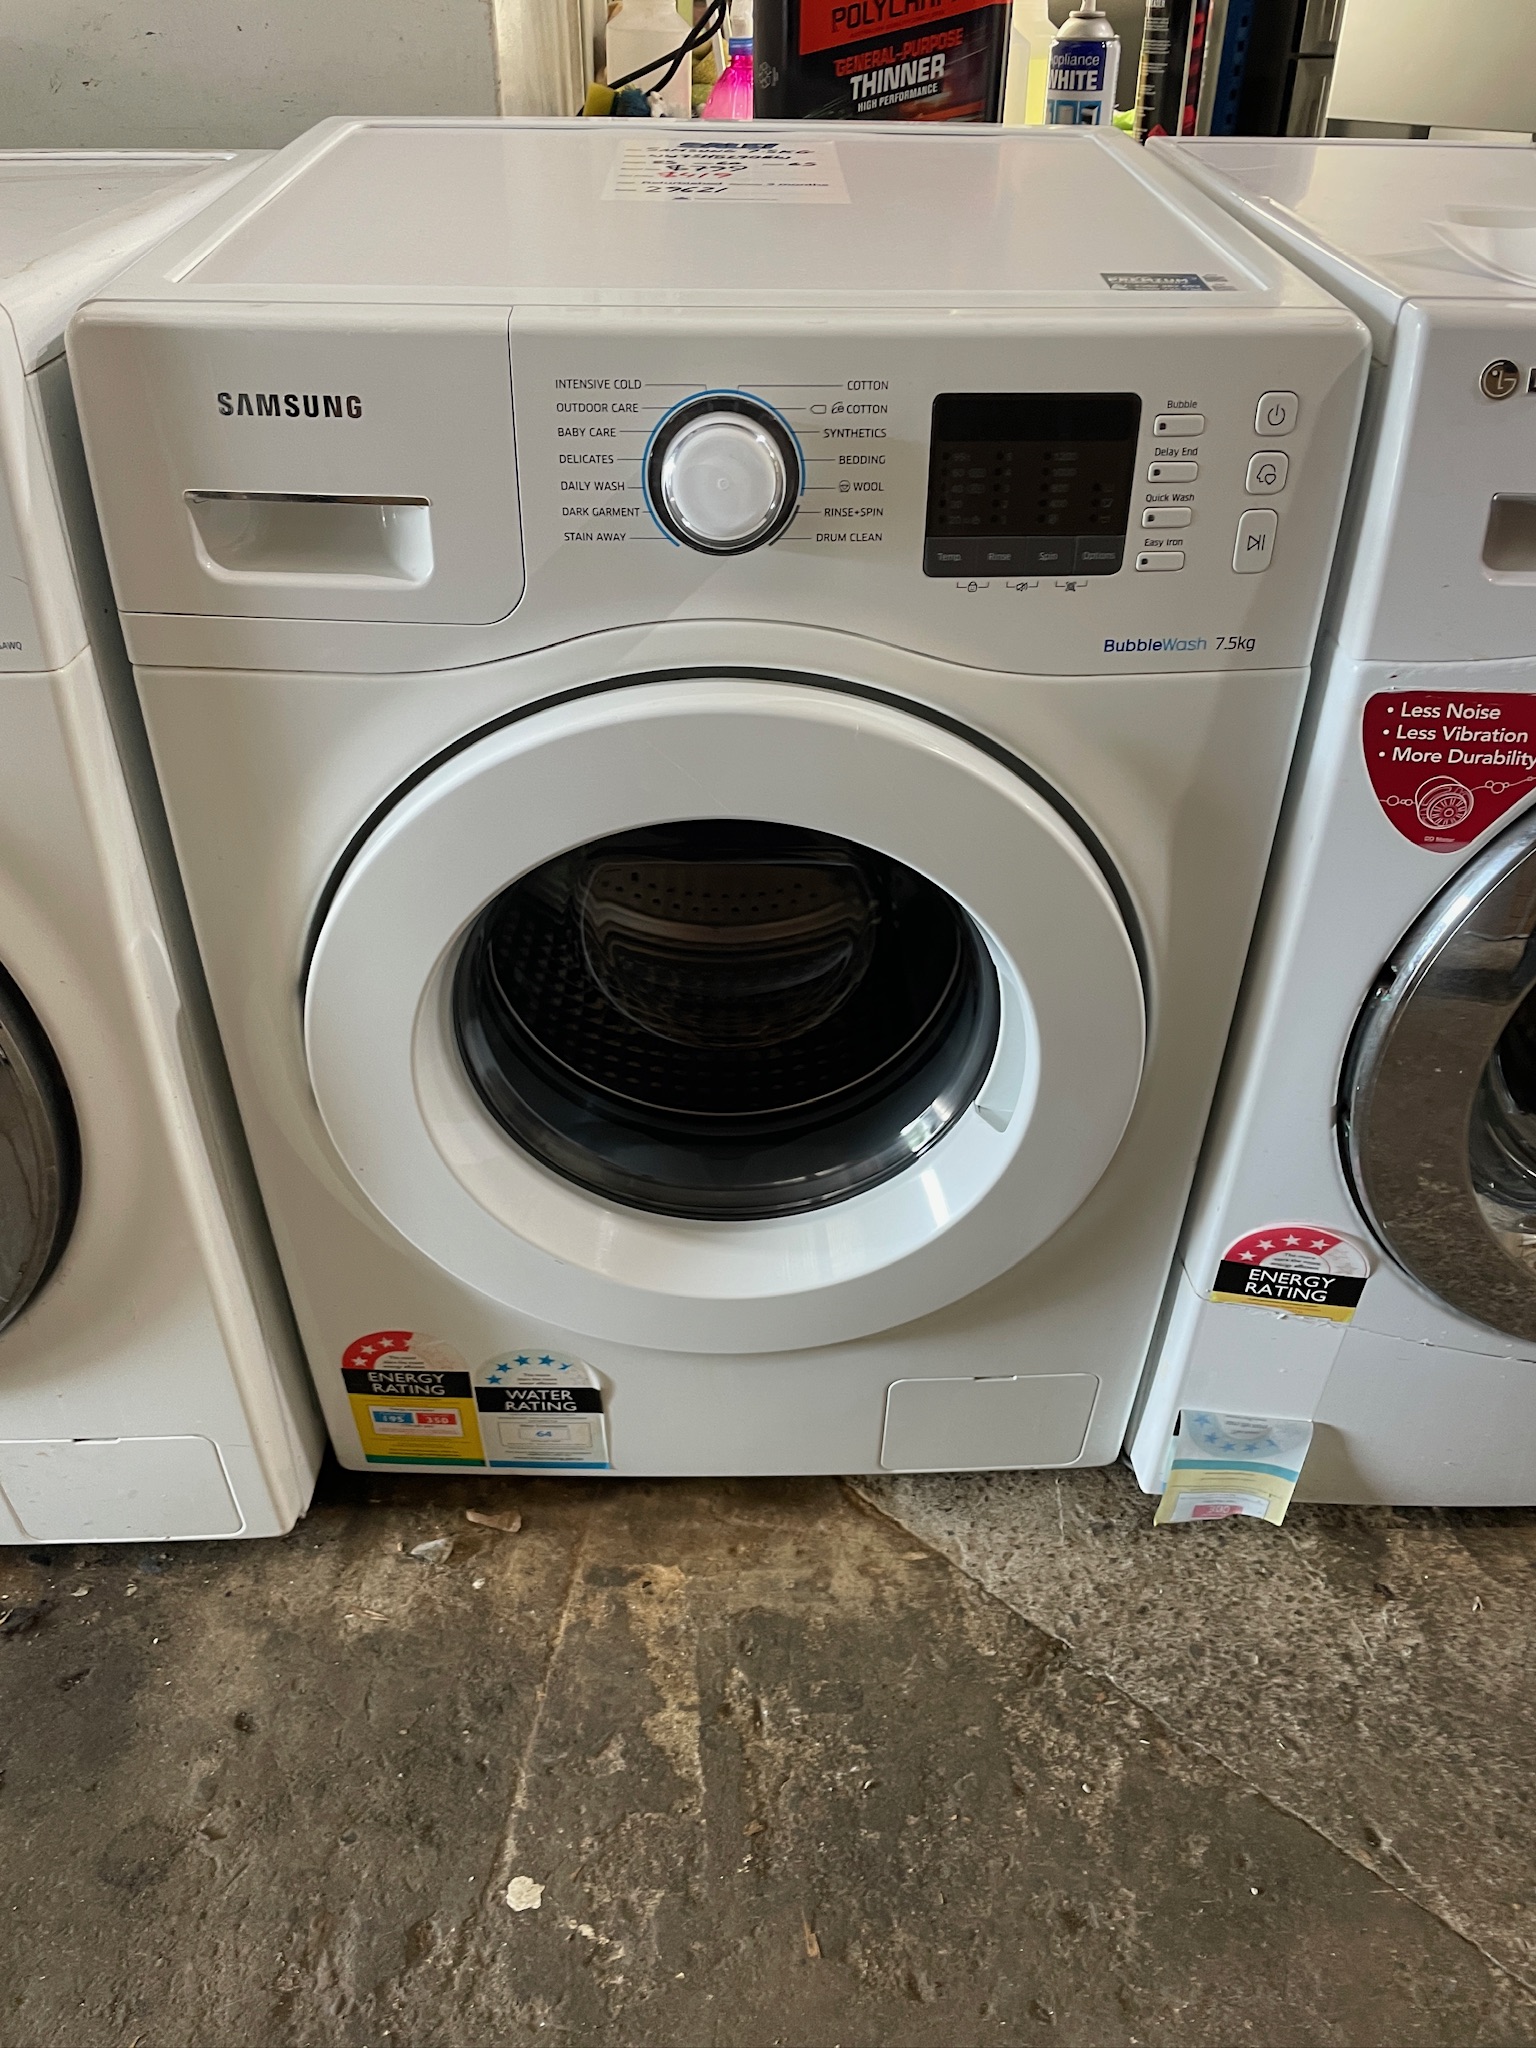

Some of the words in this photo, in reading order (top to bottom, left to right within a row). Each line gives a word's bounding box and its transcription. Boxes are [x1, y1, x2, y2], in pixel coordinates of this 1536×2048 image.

[834, 28, 964, 77] GENERAL-PURPOSE
[850, 53, 945, 100] THINNER
[1049, 69, 1098, 90] WHITE
[858, 99, 877, 112] HIGH
[879, 83, 938, 106] PERFORMANCE
[555, 379, 611, 389] INTENSIVE
[614, 379, 642, 389] COLD
[847, 380, 889, 390] COTTON
[217, 392, 363, 419] SAMSUNG
[556, 403, 609, 413] OUTDOOR
[612, 403, 639, 413] CARE
[846, 404, 888, 414] COTTON
[1167, 400, 1197, 409] Bubble
[558, 427, 586, 437] BABY
[589, 427, 617, 437] CARE
[824, 428, 887, 438] SYNTHETICS
[1154, 447, 1180, 458] Delay
[1182, 447, 1198, 456] End
[559, 454, 614, 464] DELICATES
[839, 455, 886, 465] BEDDING
[560, 481, 591, 492] DAILY
[593, 481, 625, 491] WASH
[853, 482, 884, 492] WOOL
[1146, 493, 1169, 503] Quick
[1172, 493, 1195, 502] Wash
[562, 507, 590, 517] DARK
[592, 507, 639, 517] GARMENT
[824, 507, 884, 517] RINSE+SPIN
[564, 532, 593, 542] STAIN
[596, 532, 626, 542] AWAY
[816, 533, 847, 542] DRUM
[850, 533, 883, 542] CLEAN
[1144, 538, 1164, 549] Easy
[1166, 538, 1183, 547] Iron
[938, 552, 962, 563] Temp
[987, 552, 1012, 562] Rinse
[1039, 552, 1058, 563] Spin
[1082, 551, 1116, 562] Options
[1104, 637, 1207, 653] BubbleWash
[1215, 636, 1256, 652] 7.5kg
[1401, 702, 1441, 718] Less
[1446, 703, 1502, 720] Noise
[1396, 724, 1436, 740] Less
[1442, 725, 1529, 743] Vibration
[1391, 747, 1442, 763] More
[1447, 749, 1536, 770] Durability
[1249, 1268, 1336, 1289] ENERGY
[1244, 1281, 1328, 1303] RATING
[367, 1371, 445, 1385] ENERGY
[372, 1383, 446, 1396] RATING
[504, 1389, 573, 1401] WATER
[504, 1400, 577, 1412] RATING
